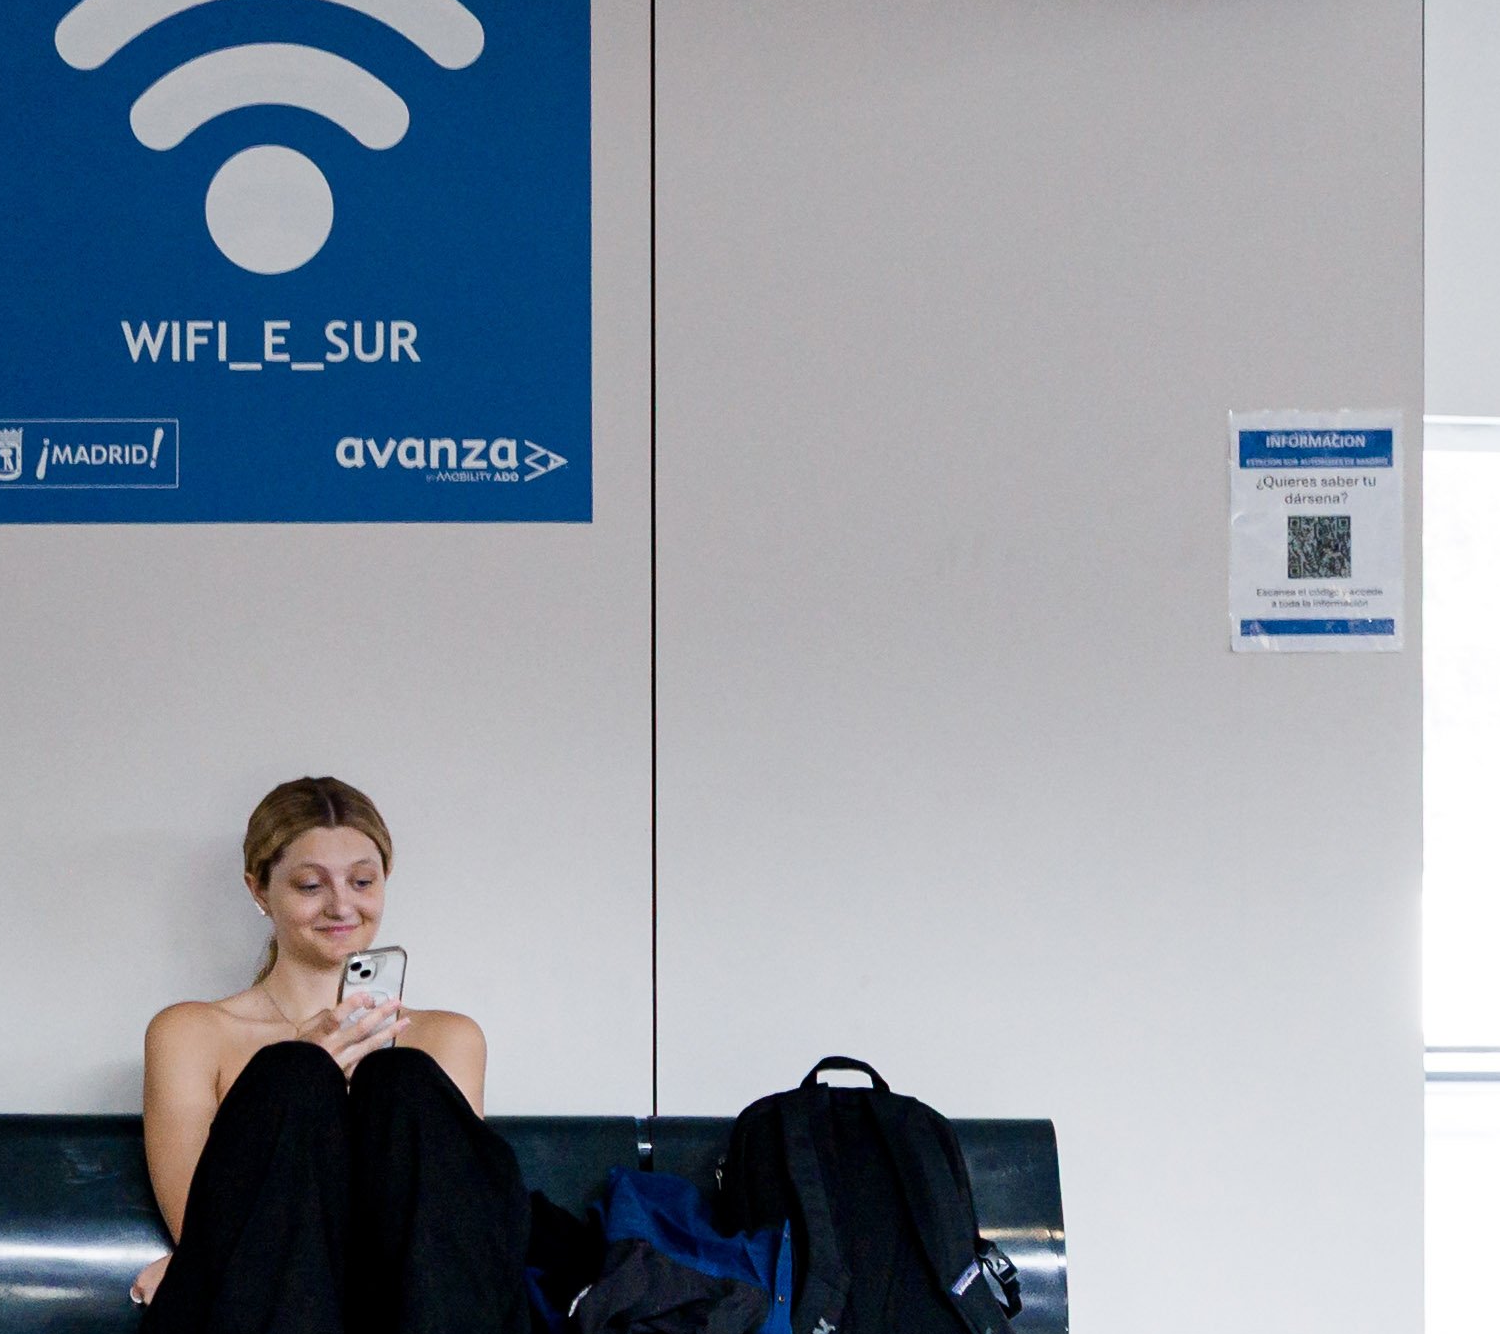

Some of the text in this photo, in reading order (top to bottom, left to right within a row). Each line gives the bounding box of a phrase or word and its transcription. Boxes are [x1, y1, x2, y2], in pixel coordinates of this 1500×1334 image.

[120, 319, 422, 371] WIFI_E_SUR
[35, 426, 165, 481] ¡MADRID!
[335, 436, 520, 470] avanza
[436, 470, 492, 482] MOBILITY
[493, 471, 520, 482] ADO
[1255, 474, 1376, 490] ¿Quieres saber tu
[1284, 491, 1349, 505] dársena?
